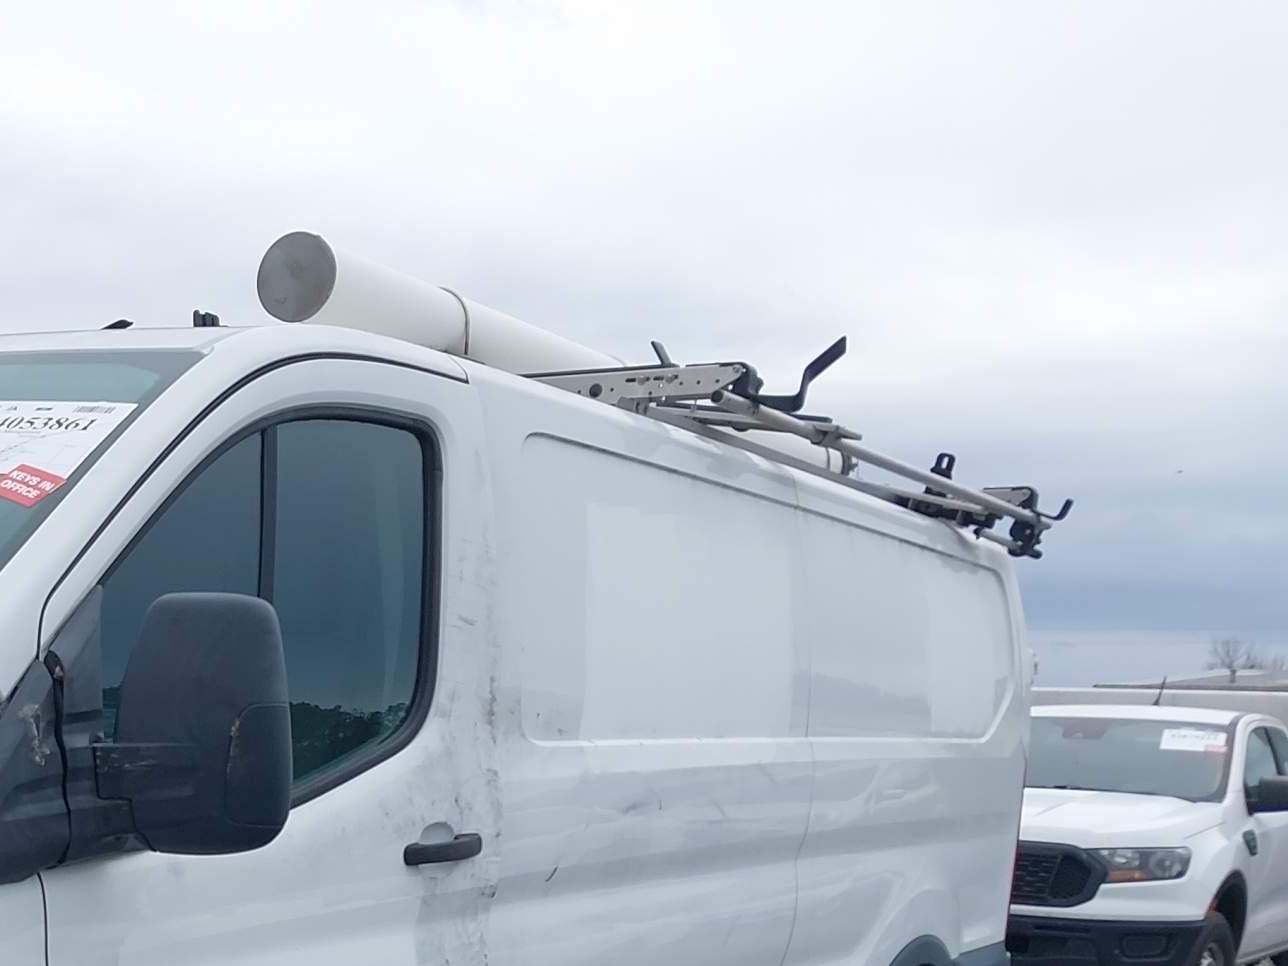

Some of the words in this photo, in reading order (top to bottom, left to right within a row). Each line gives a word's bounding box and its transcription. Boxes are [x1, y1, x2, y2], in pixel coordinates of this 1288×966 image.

[0, 479, 41, 499] OFFICE
[9, 469, 41, 486] KEYS
[38, 480, 56, 492] IN
